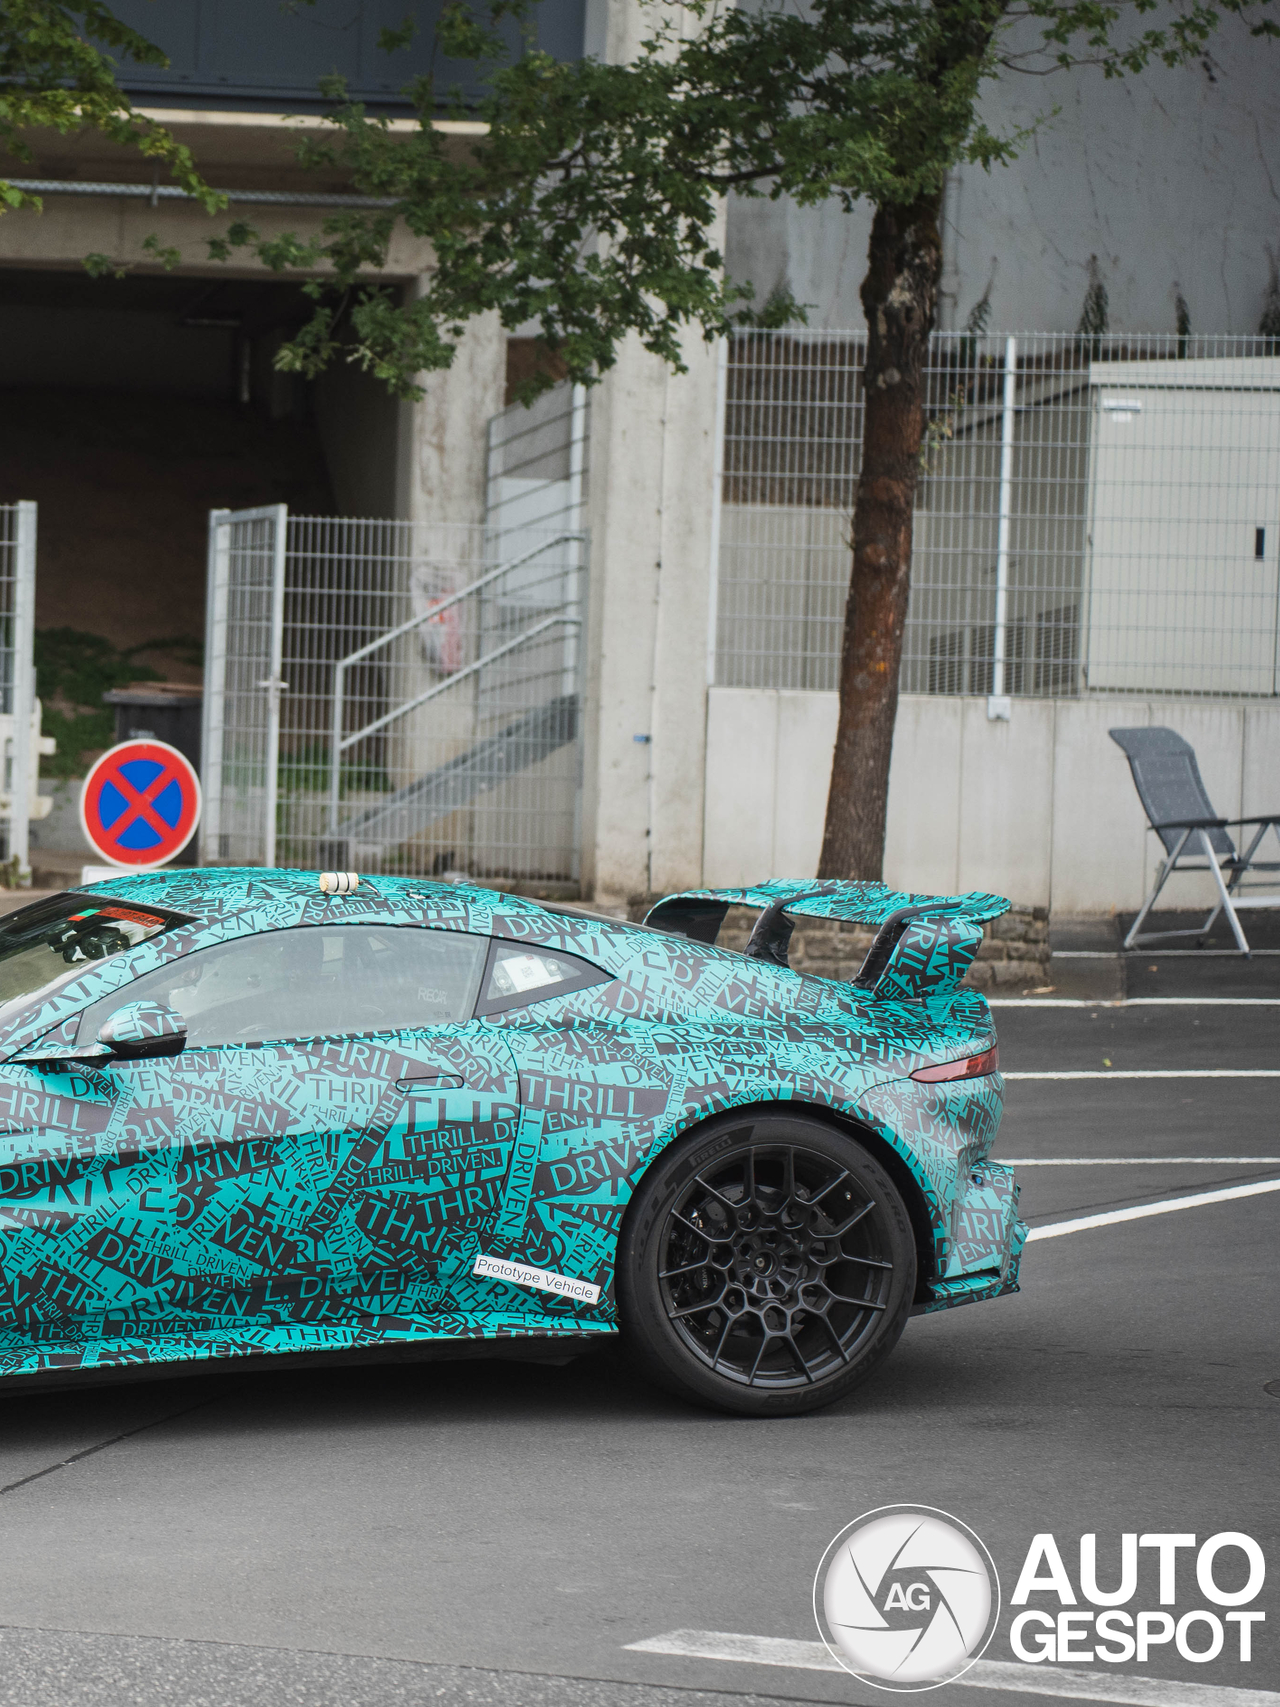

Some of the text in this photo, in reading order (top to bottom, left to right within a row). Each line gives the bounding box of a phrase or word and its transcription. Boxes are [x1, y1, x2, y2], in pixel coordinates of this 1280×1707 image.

[394, 899, 460, 911] DRIVEN.
[676, 1042, 765, 1055] DRIVEN.
[239, 1067, 280, 1099] RIVEN.
[523, 1074, 645, 1119] THRILL
[406, 1122, 489, 1154] THRILL.
[687, 1134, 732, 1168] PIRELLI
[428, 1151, 501, 1176] DRIVEN.
[550, 1140, 631, 1192] DRIV
[305, 1155, 367, 1234] DRIVEN.
[63, 1197, 131, 1249] THRILL.
[180, 1198, 239, 1248] HRILL.
[97, 1233, 174, 1285] DRIV
[196, 1253, 251, 1279] DRIVEN.
[328, 1223, 354, 1289] RIVEN.
[476, 1257, 594, 1300] Prototype Vehicle
